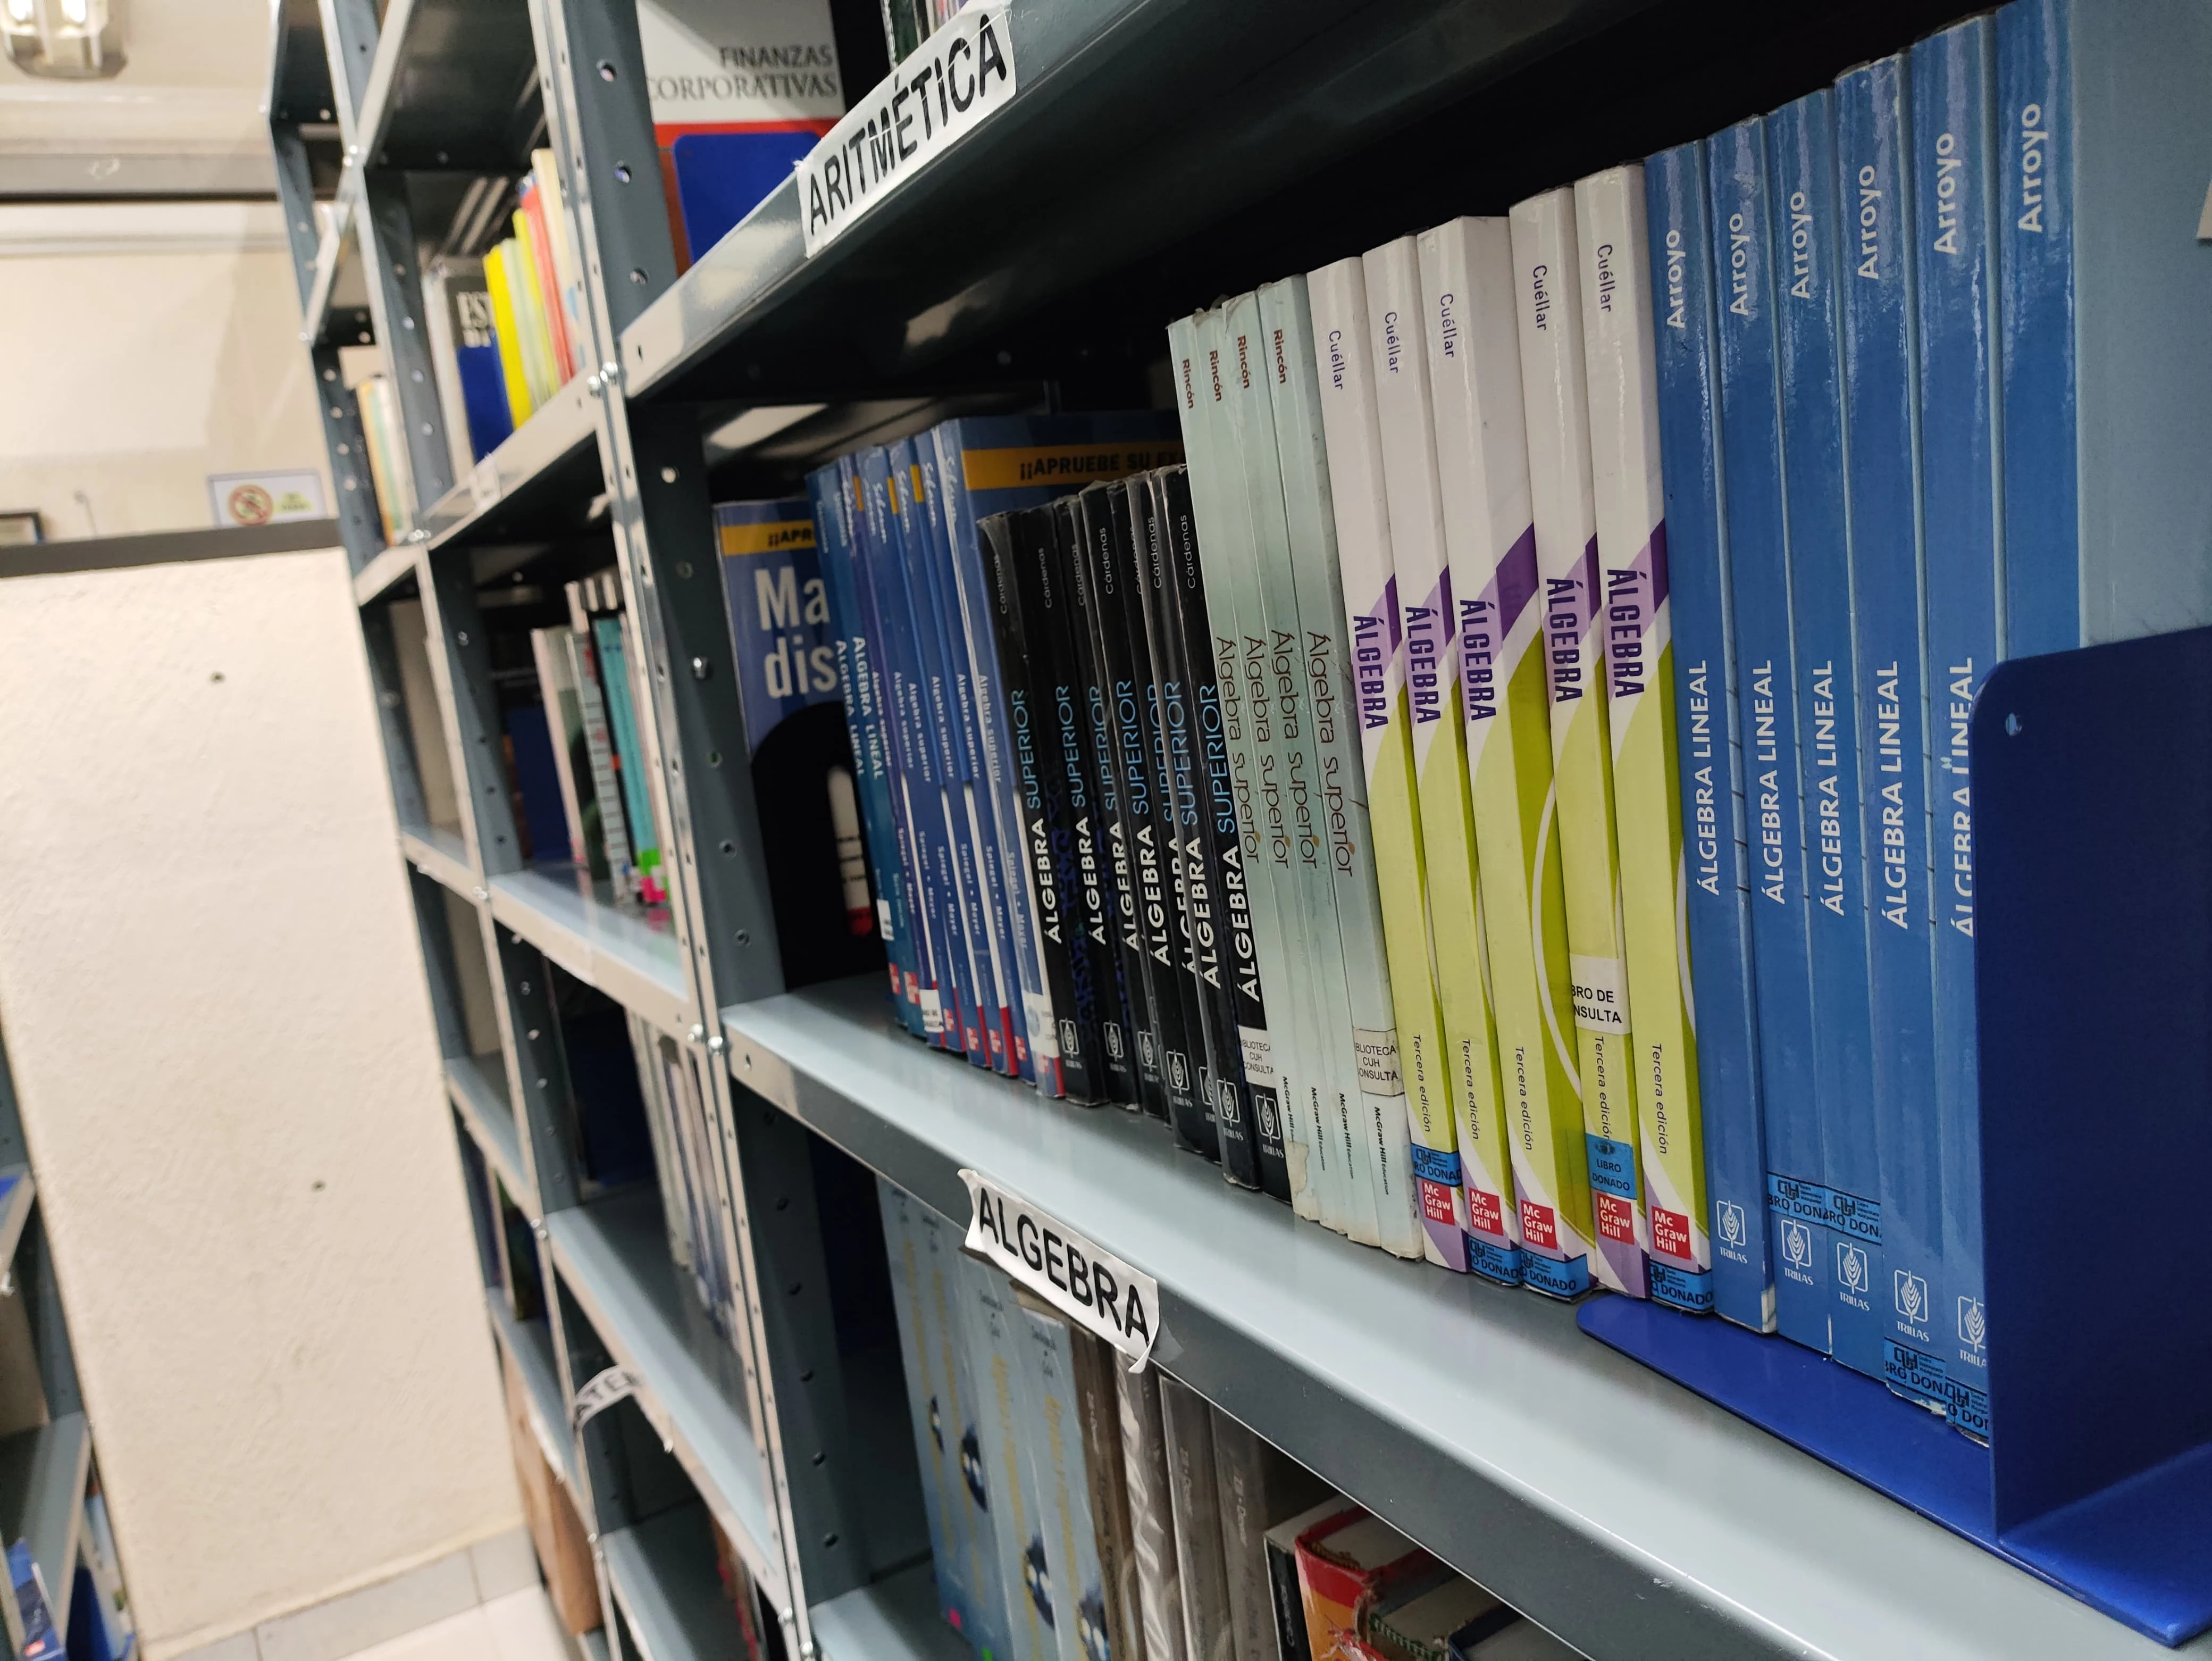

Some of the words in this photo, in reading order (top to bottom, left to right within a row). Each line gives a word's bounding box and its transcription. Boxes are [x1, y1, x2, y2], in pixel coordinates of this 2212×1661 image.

[718, 45, 833, 69] FINANZAS
[808, 14, 1008, 236] ARITMÉTICA
[1934, 132, 1962, 255] Arroyo
[2018, 103, 2049, 233] Arroyo
[1790, 191, 1813, 299] Arroyo
[1858, 165, 1882, 280] Arroyo
[1597, 244, 1615, 312] Cuéllar
[1666, 230, 1686, 329] Arroyo
[1730, 213, 1750, 316] Arroyo
[1440, 294, 1457, 358] Cuéllar
[1533, 265, 1551, 331] Cuéllar
[1237, 335, 1251, 389] Rincón
[1273, 329, 1287, 384] Rincón
[1329, 330, 1345, 390] Cuéllar
[1385, 312, 1399, 373] Cuéllar
[1182, 358, 1195, 409] Rincón
[1209, 350, 1223, 402] Rincón
[1127, 453, 1150, 470] SU
[1038, 548, 1052, 608] Cárdenas
[1100, 527, 1114, 594] Cárdenas
[1147, 516, 1161, 588] Cárdenas
[1180, 515, 1195, 589] Cárdenas
[754, 567, 830, 631] Ma
[1405, 606, 1441, 723] ÁLGEBRA
[1460, 599, 1496, 721] ÁLGEBRA
[1546, 578, 1583, 703] ÁLGEBRA
[1607, 569, 1647, 698] ÁLGEBRA
[764, 636, 837, 699] dis
[1353, 615, 1388, 729] ÁLGEBRA
[1688, 660, 1711, 758] LINEAL
[1753, 660, 1777, 762] LINEAL
[1813, 661, 1837, 767] LINEAL
[1876, 661, 1901, 772] LINEAL
[865, 724, 884, 779] LINEAL
[1011, 689, 1041, 809] SUPERIOR
[1056, 686, 1086, 808] SUPERIOR
[1117, 680, 1149, 815] SUPERIOR
[1164, 681, 1198, 826] SUPERIOR
[1200, 685, 1235, 834] SUPERIOR
[1216, 637, 1241, 740] Álgebra
[1231, 752, 1261, 864] superior
[1244, 636, 1270, 742] Álgebra
[1260, 754, 1291, 869] superior
[1271, 629, 1299, 740] Álgebra
[1287, 752, 1319, 869] superior
[1306, 631, 1335, 744] Álgebra
[1323, 756, 1355, 877] superior
[1694, 765, 1720, 896] ÁLGEBRA
[1759, 770, 1785, 905] ÁLGEBRA
[1818, 775, 1845, 916] ÁLGEBRA
[1881, 781, 1908, 930] ÁLGEBRA
[1031, 817, 1062, 944] ÁLGEBRA
[1075, 816, 1106, 945] ÁLGEBRA
[1137, 825, 1171, 966] ÁLGEBRA
[1186, 837, 1221, 989] ÁLGEBRA
[1222, 846, 1260, 1003] ÁLGEBRA
[1597, 989, 1614, 1003] DE
[1250, 1051, 1262, 1062] CUH
[1358, 1067, 1398, 1081] ONSULTA
[1362, 1057, 1380, 1069] CUH
[1413, 1034, 1425, 1081] Tercera
[1419, 1086, 1432, 1132] edición
[1595, 1036, 1605, 1087] Tercera
[1652, 1044, 1663, 1097] Tercera
[1283, 1076, 1292, 1112] McGraw
[1311, 1087, 1320, 1124] McGraw
[1339, 1093, 1348, 1131] McGraw
[1462, 1039, 1473, 1087] Tercera
[1468, 1092, 1480, 1140] edición
[1515, 1047, 1527, 1097] Tercera
[1521, 1101, 1534, 1150] edición
[1374, 1106, 1383, 1146] McGraw
[1656, 1101, 1669, 1154] edición
[1424, 1182, 1439, 1197] Mc
[1592, 1173, 1630, 1191] DONADO
[1596, 1158, 1621, 1173] LIBRO
[1425, 1194, 1451, 1211] Graw
[1427, 1205, 1443, 1220] Hill
[1471, 1191, 1487, 1206] Mc
[1472, 1204, 1499, 1220] Graw
[1473, 1215, 1490, 1230] Hill
[1523, 1204, 1540, 1219] Mc
[1524, 1216, 1553, 1234] Graw
[1600, 1197, 1617, 1213] Mc
[1600, 1211, 1630, 1228] Graw
[1654, 1211, 1673, 1227] Mc
[1526, 1228, 1544, 1243] Hill
[1602, 1223, 1621, 1239] Hill
[1655, 1225, 1687, 1243] Graw
[1657, 1237, 1677, 1253] Hill
[1719, 1246, 1748, 1264] TRILLAS
[979, 1187, 1150, 1345] ALGEBRA
[1530, 1270, 1577, 1291] DONADO
[1661, 1284, 1713, 1305] DONADO
[1783, 1267, 1814, 1286] TRILLAS
[1839, 1291, 1870, 1311] TRILLAS
[1896, 1321, 1930, 1343] TRILLAS
